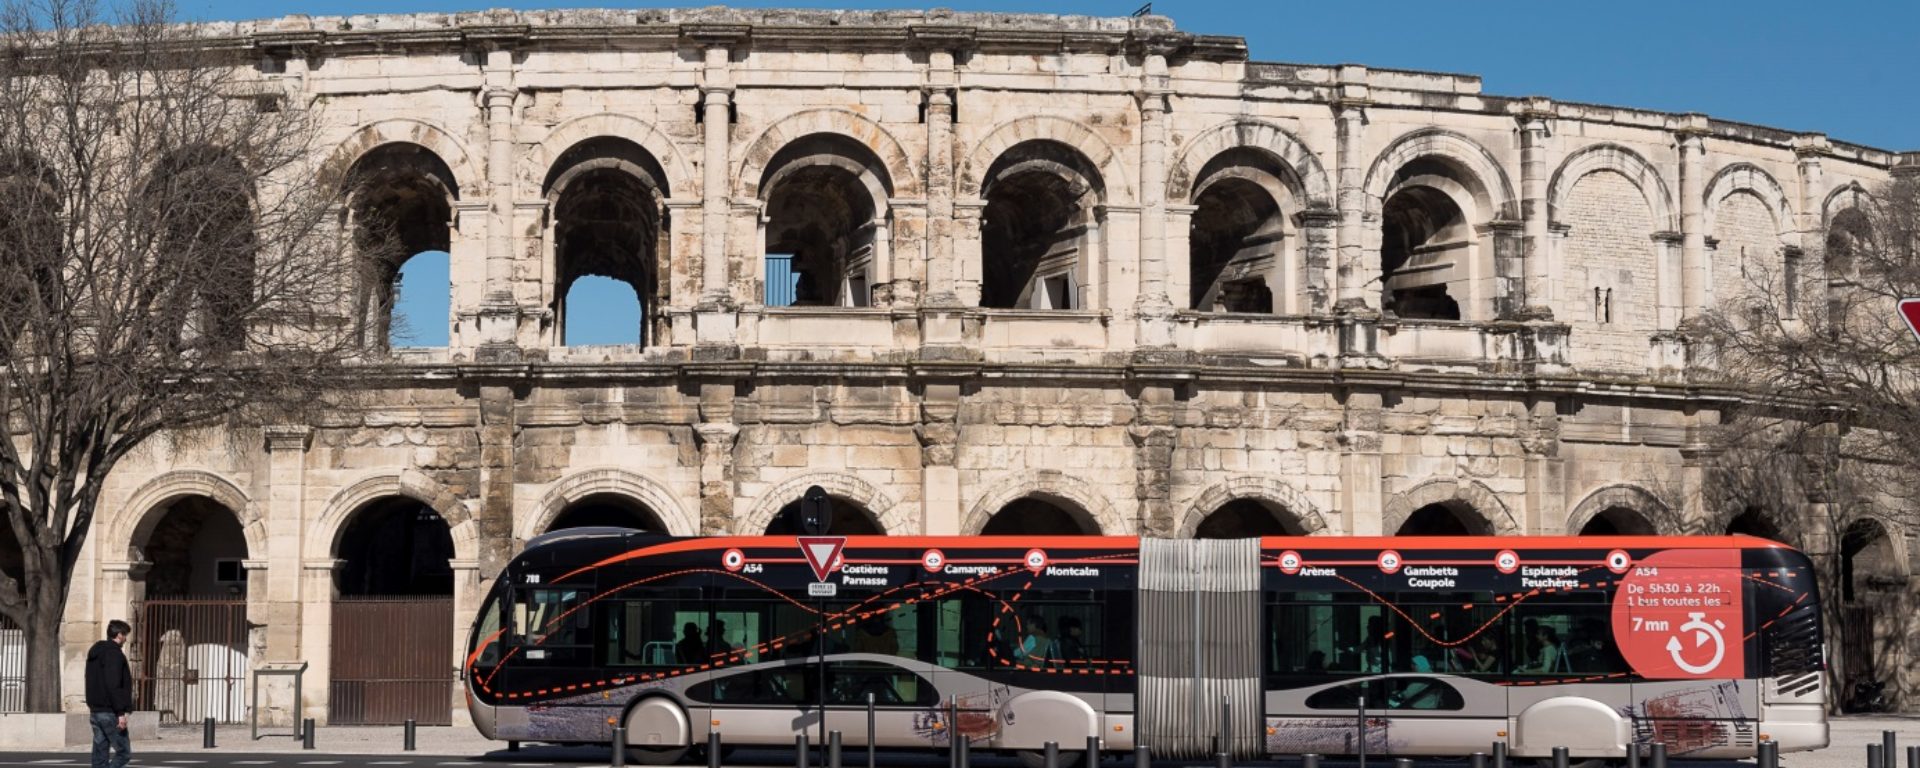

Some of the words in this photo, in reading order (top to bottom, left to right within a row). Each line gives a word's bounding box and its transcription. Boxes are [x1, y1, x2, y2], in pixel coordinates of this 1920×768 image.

[743, 563, 763, 573] A54
[842, 562, 888, 574] Costières
[944, 564, 998, 577] Camargue
[1046, 565, 1099, 576] Montcalm
[1300, 566, 1336, 577] Arènes
[1403, 566, 1458, 576] Gambetta
[1521, 566, 1578, 578] Esplanade
[1635, 567, 1658, 576] A54
[842, 575, 887, 586] Parnasse
[1408, 578, 1455, 588] Coupole
[1521, 577, 1579, 588] Feuchères
[1627, 583, 1644, 594] De
[1649, 583, 1680, 594] 5h30
[1685, 583, 1692, 593] à
[1698, 583, 1720, 593] 22h
[1628, 596, 1634, 606] 1
[1638, 596, 1659, 606] bus
[1662, 597, 1700, 607] toutes
[1704, 596, 1720, 607] les
[1632, 617, 1643, 632] 7
[1645, 620, 1669, 631] mn
